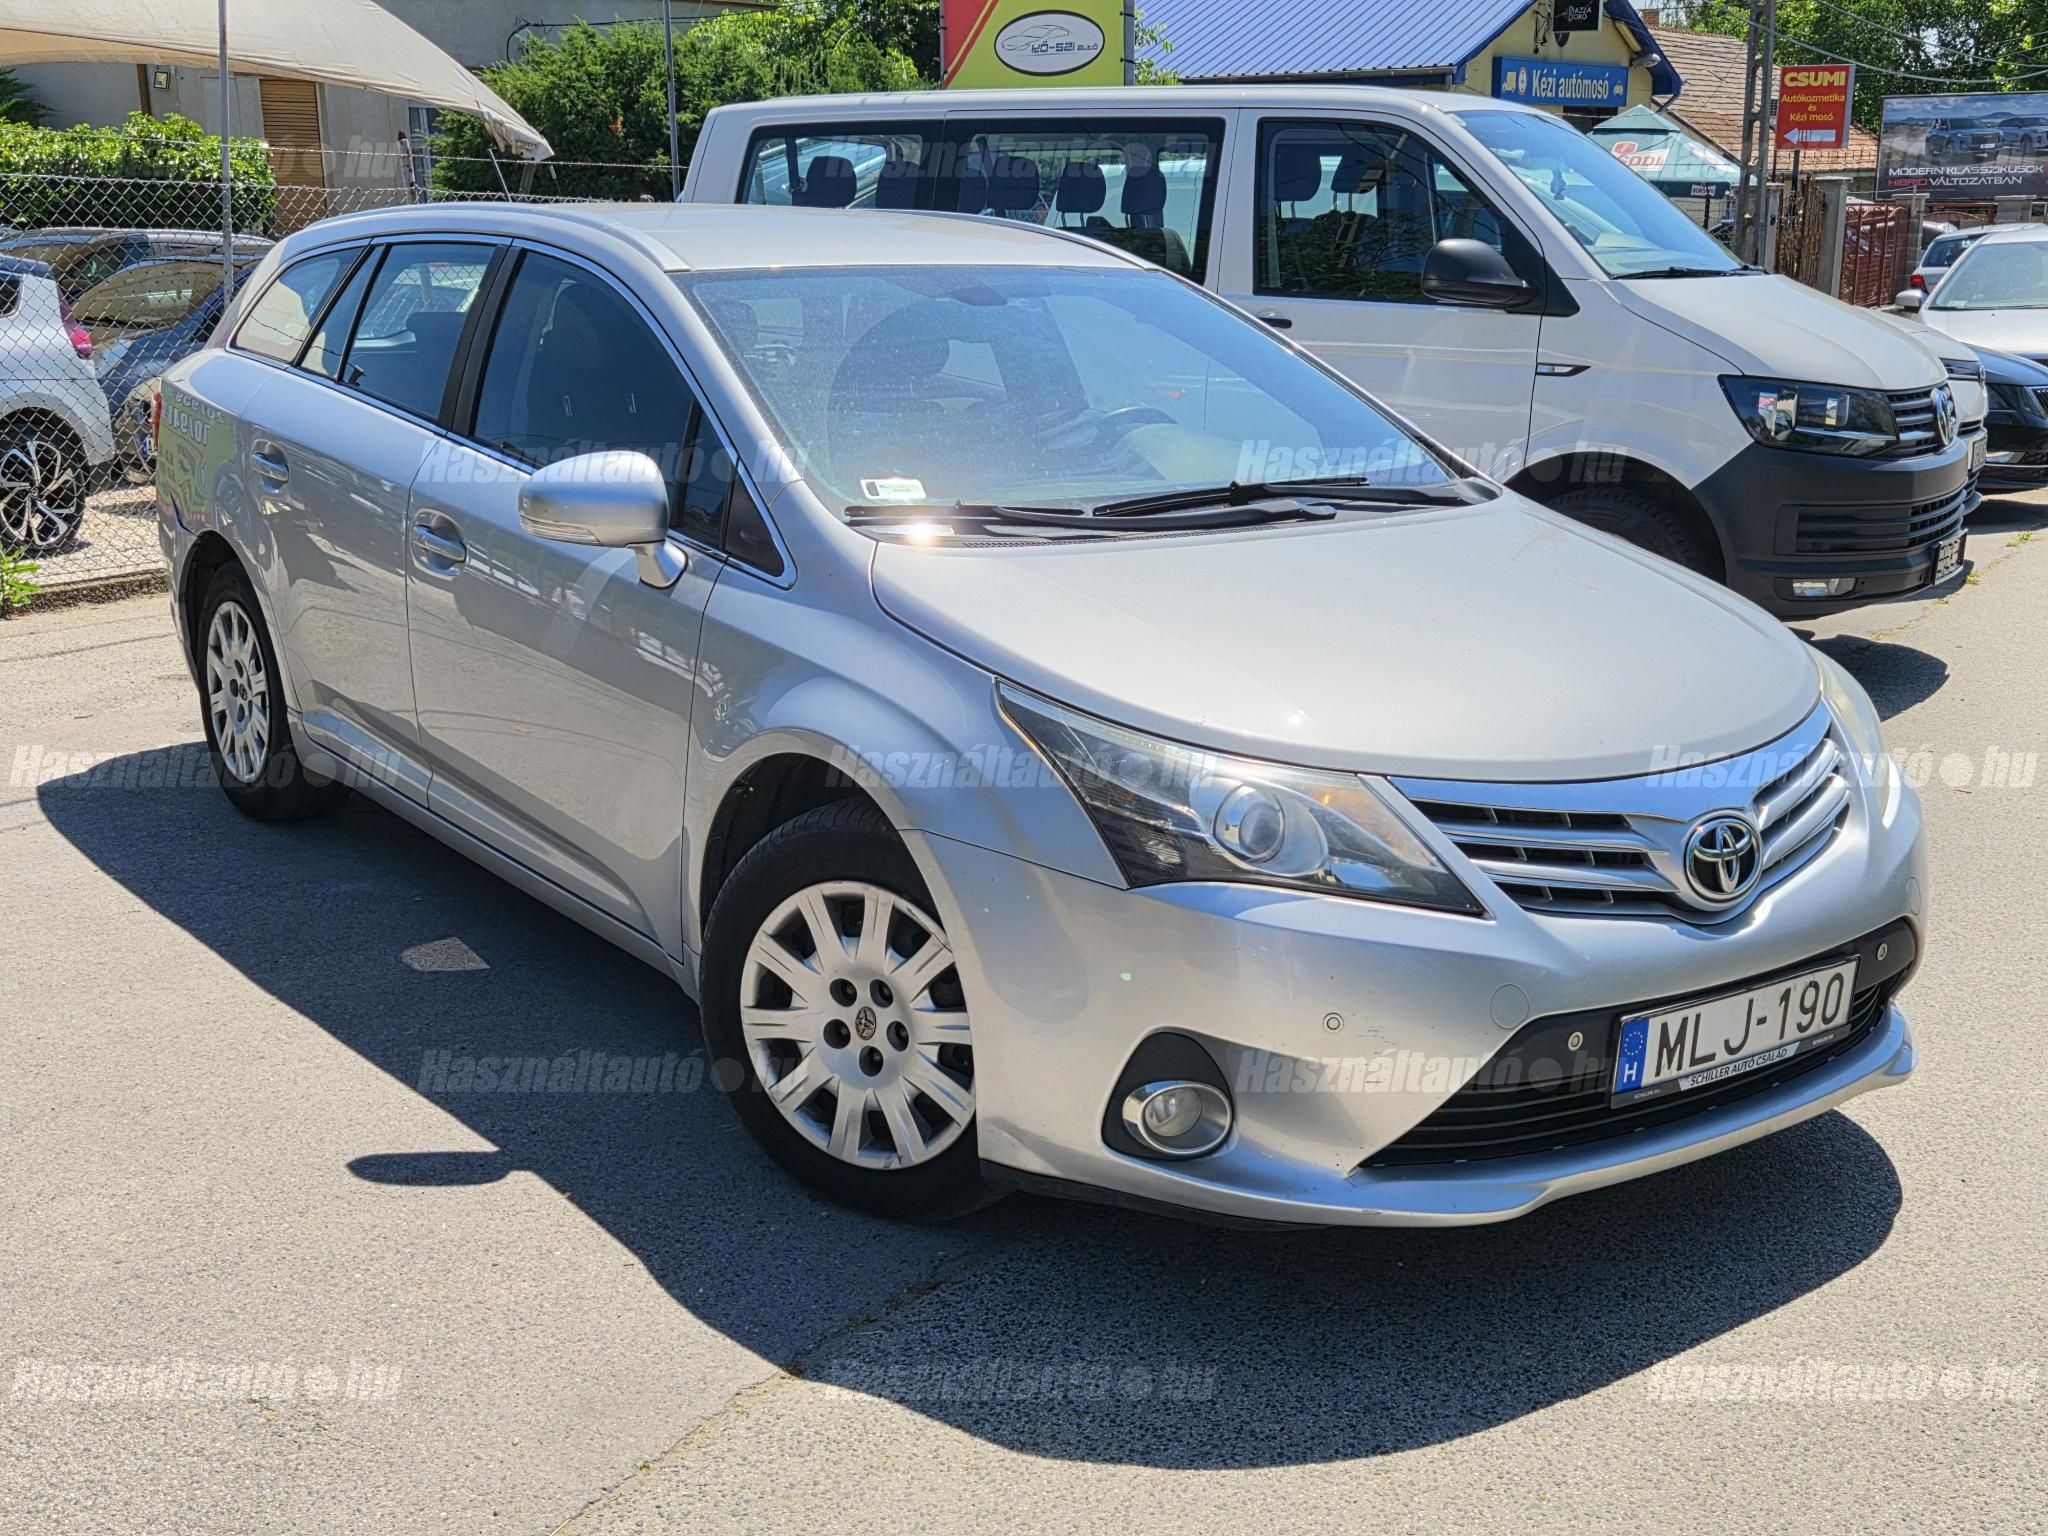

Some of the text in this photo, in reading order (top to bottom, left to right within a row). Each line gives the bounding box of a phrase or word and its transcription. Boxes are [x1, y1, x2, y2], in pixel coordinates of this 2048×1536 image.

[1532, 68, 1609, 99] Kézi autómosó
[1784, 71, 1846, 87] CSUMI
[1782, 93, 1845, 103] Autókozmetika
[1807, 103, 1817, 112] és
[1789, 112, 1834, 121] Kézi mosó
[1888, 165, 2043, 176] MODERN KLASSZIKUSOK
[1888, 176, 2022, 186] HIBRID VÁLTOZATBAN
[1654, 972, 1844, 1078] MLJ-190
[1623, 1061, 1638, 1083] H
[1690, 1048, 1788, 1086] SCHILLER AUTÓ CSALÁD
